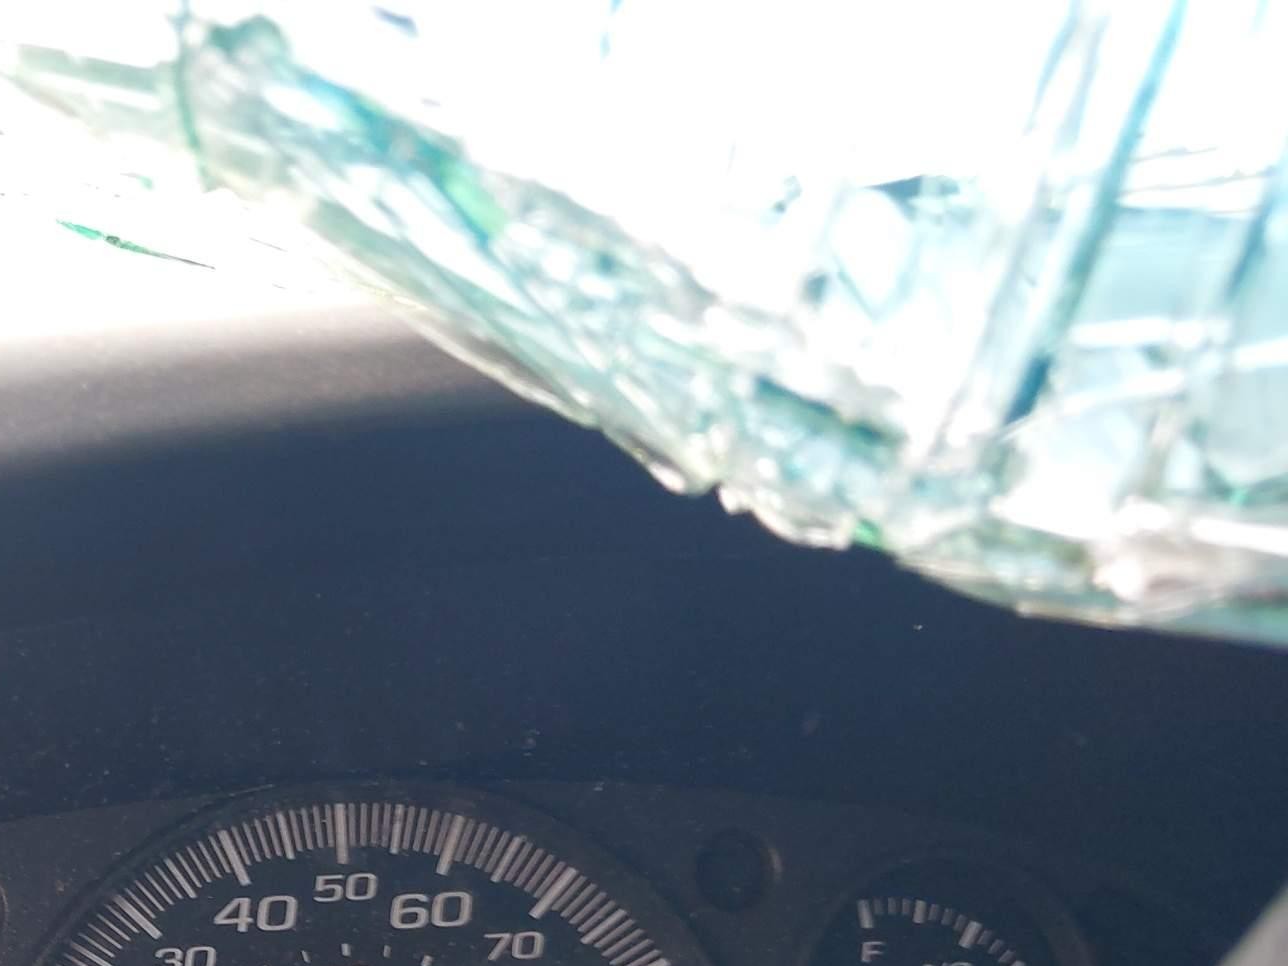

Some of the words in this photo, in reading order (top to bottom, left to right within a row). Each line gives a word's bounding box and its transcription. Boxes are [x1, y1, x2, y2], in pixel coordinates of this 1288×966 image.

[313, 872, 378, 902] 50
[213, 895, 298, 932] 40
[389, 891, 473, 929] 60
[484, 931, 544, 961] 70
[861, 941, 886, 963] F
